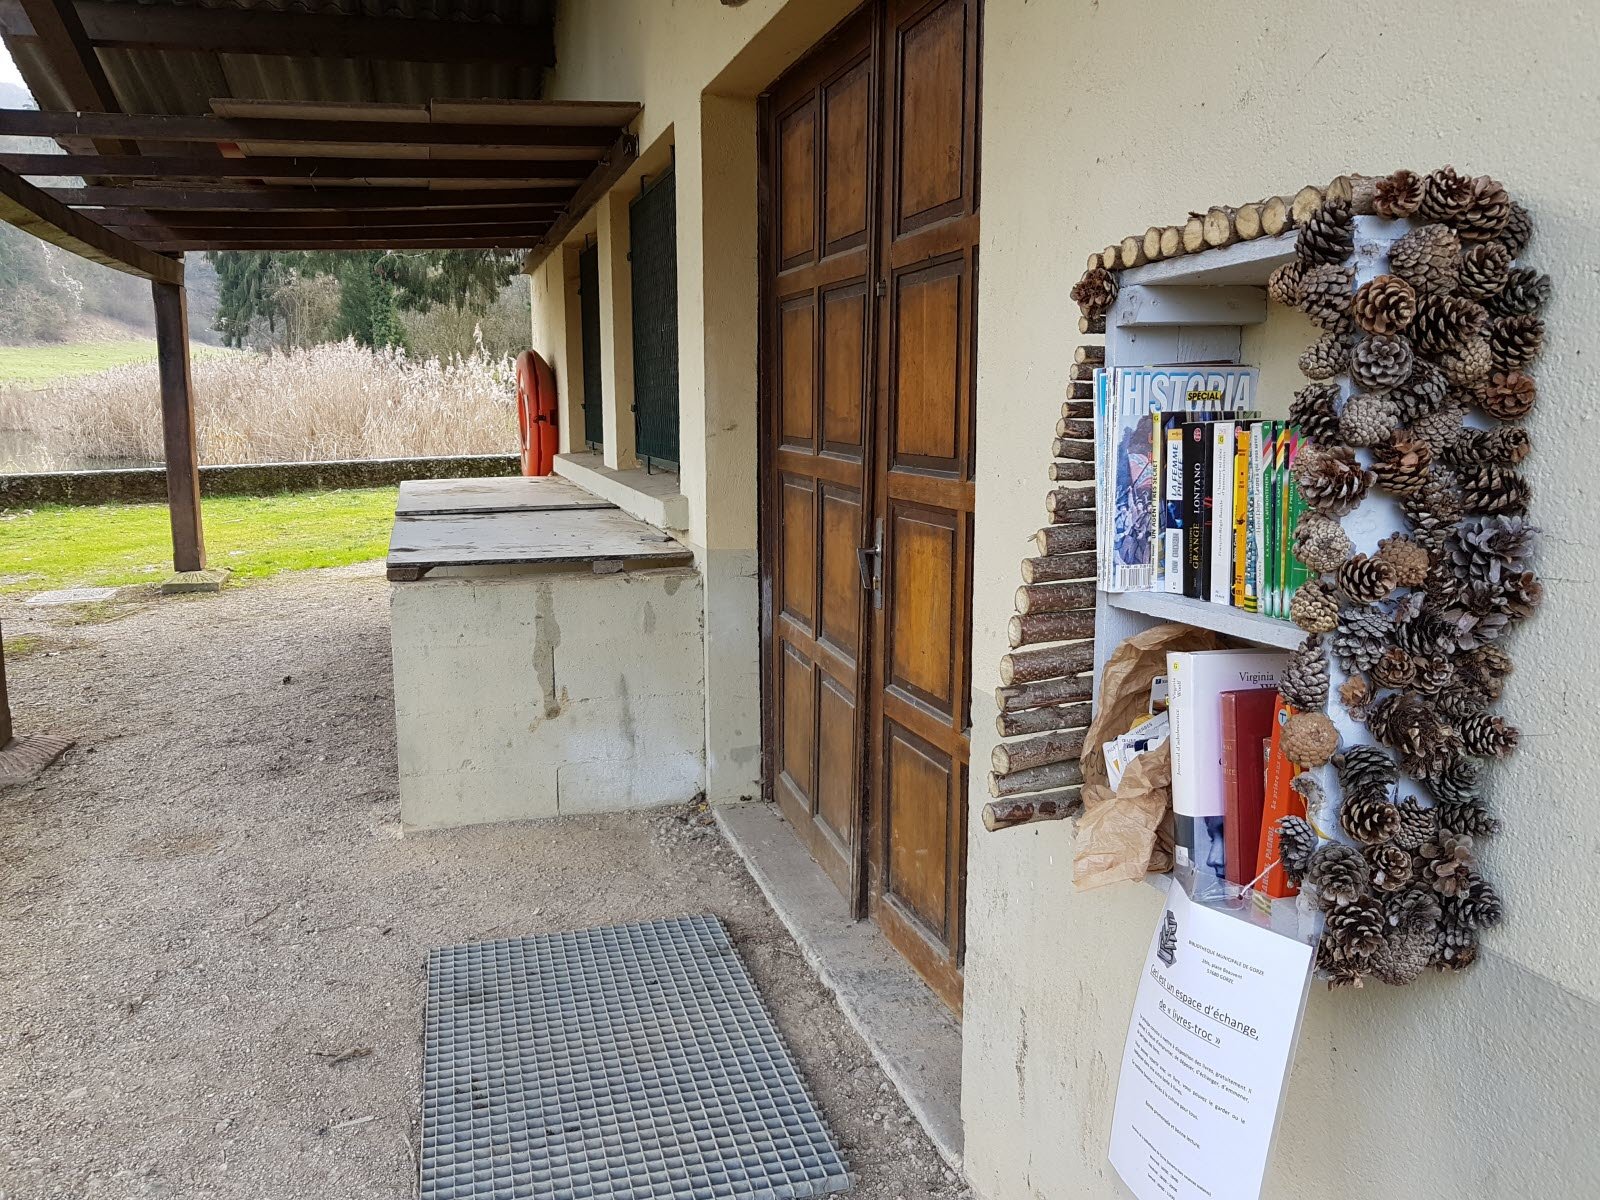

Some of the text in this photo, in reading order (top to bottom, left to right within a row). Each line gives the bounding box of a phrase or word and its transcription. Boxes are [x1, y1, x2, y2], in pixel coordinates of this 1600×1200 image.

[1122, 372, 1251, 415] HISTORIA
[1171, 485, 1178, 497] LA
[1193, 463, 1201, 514] LONTANO
[1151, 529, 1156, 539] UN
[1239, 671, 1275, 684] Virginia
[1265, 825, 1276, 860] PAGNOL
[1216, 952, 1242, 966] MUNICIPALE
[1249, 966, 1265, 976] GORZE
[1151, 964, 1159, 979] Ceci
[1167, 982, 1175, 991] un
[1175, 990, 1202, 1010] espace
[1204, 1005, 1259, 1040] d'échange,
[1159, 999, 1167, 1011] de
[1172, 1008, 1214, 1041] livres-troc
[1214, 1104, 1230, 1116] garder
